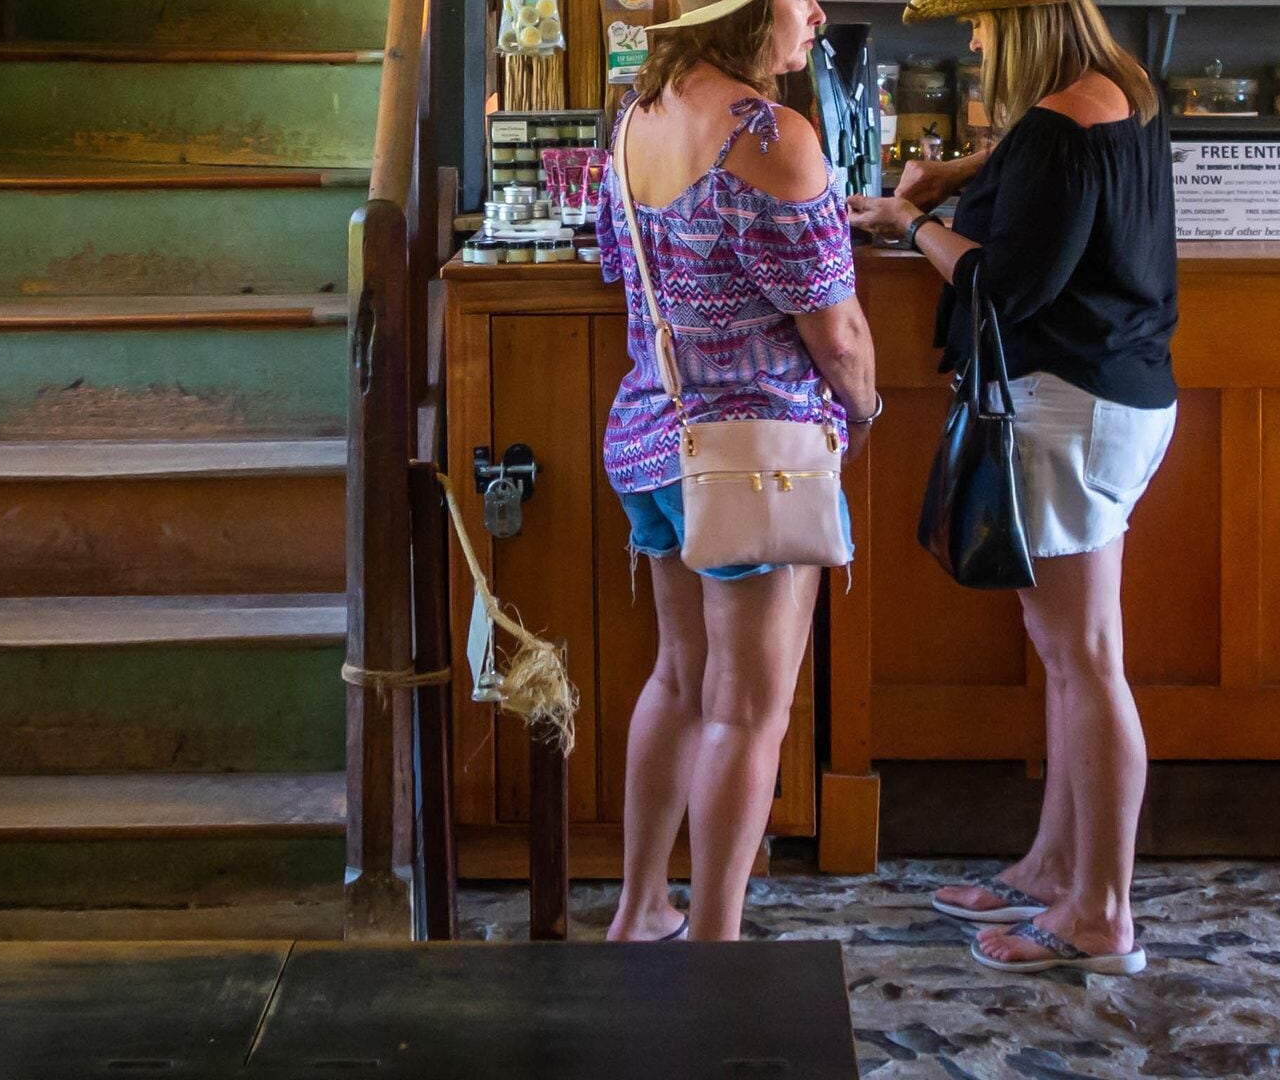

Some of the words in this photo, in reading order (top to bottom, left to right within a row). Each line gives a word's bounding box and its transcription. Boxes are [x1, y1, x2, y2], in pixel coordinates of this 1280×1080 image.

[1201, 146, 1239, 158] FREE
[1176, 175, 1187, 185] IN
[1191, 175, 1222, 185] NOW
[1195, 227, 1222, 238] heaps
[1225, 226, 1237, 236] of
[1237, 227, 1262, 236] other
